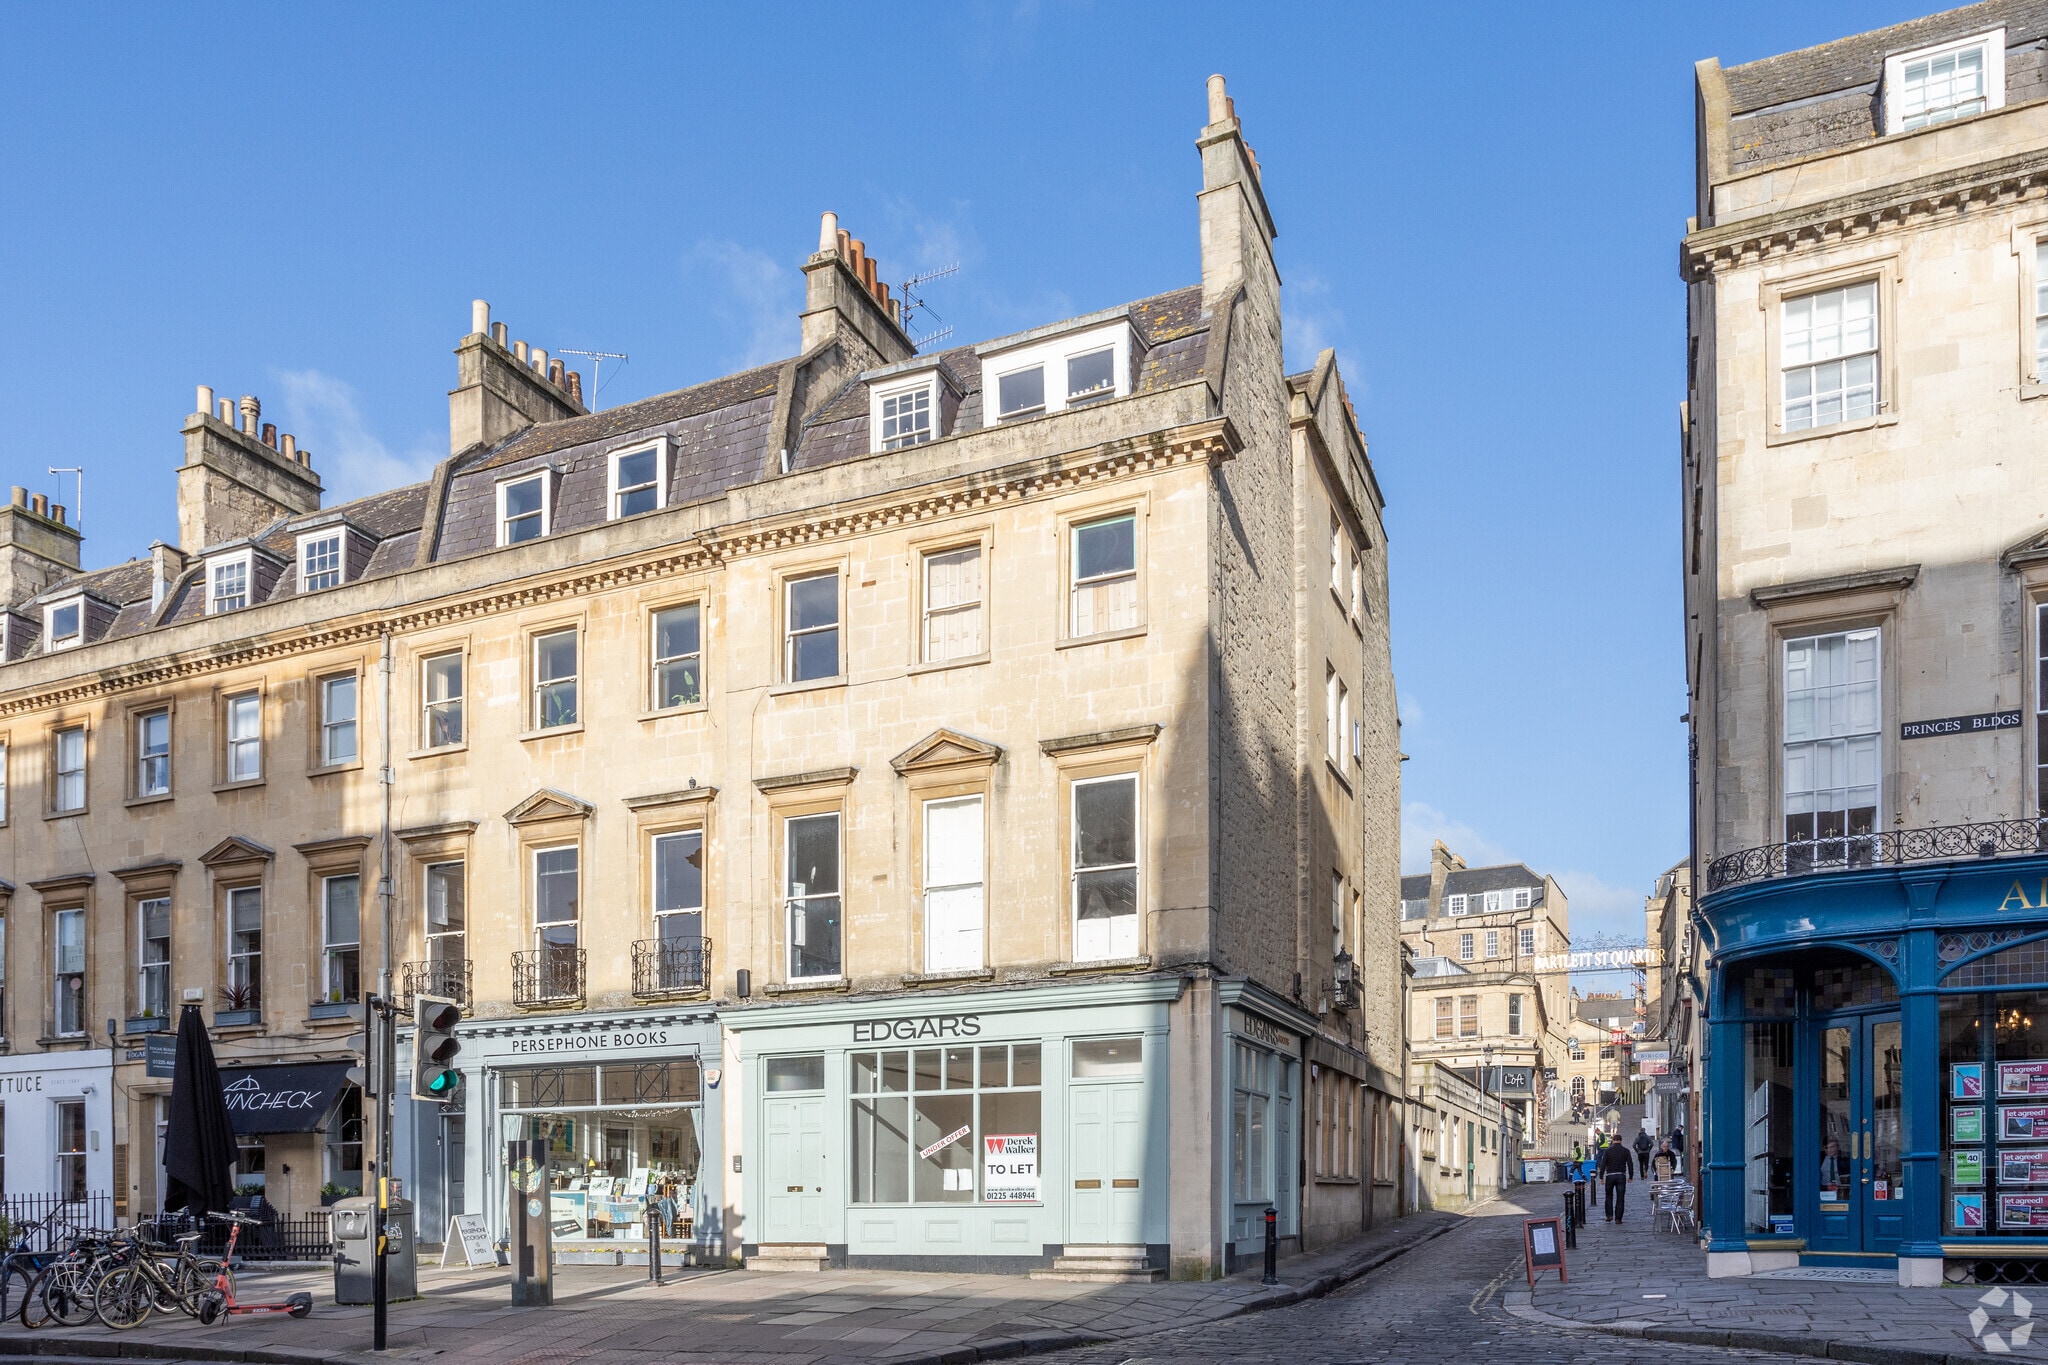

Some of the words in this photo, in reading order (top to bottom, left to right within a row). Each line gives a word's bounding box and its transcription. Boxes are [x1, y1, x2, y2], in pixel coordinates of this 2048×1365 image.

[1903, 720, 1961, 736] PRINCES
[1972, 713, 2020, 729] BLDGS
[1534, 952, 1593, 970] BARTLETT
[1594, 950, 1610, 967] ST
[853, 1014, 981, 1042] EDGARS
[1244, 1013, 1279, 1046] EDGARS
[512, 1034, 608, 1052] PERSEPHONE
[614, 1031, 667, 1047] BOOKS
[2013, 1065, 2042, 1074] agreed!
[2018, 1109, 2046, 1118] agreed!
[922, 1141, 946, 1157] UNDER
[946, 1127, 968, 1143] OFFER
[1007, 1136, 1034, 1146] Derek
[1005, 1145, 1036, 1154] Walker
[1967, 1154, 1978, 1162] 40
[2015, 1152, 2043, 1162] agreed!
[987, 1164, 1006, 1175] TO
[1010, 1163, 1033, 1174] LET
[986, 1192, 1007, 1200] 01225
[1009, 1191, 1035, 1200] 448944
[2015, 1196, 2044, 1206] agreed!
